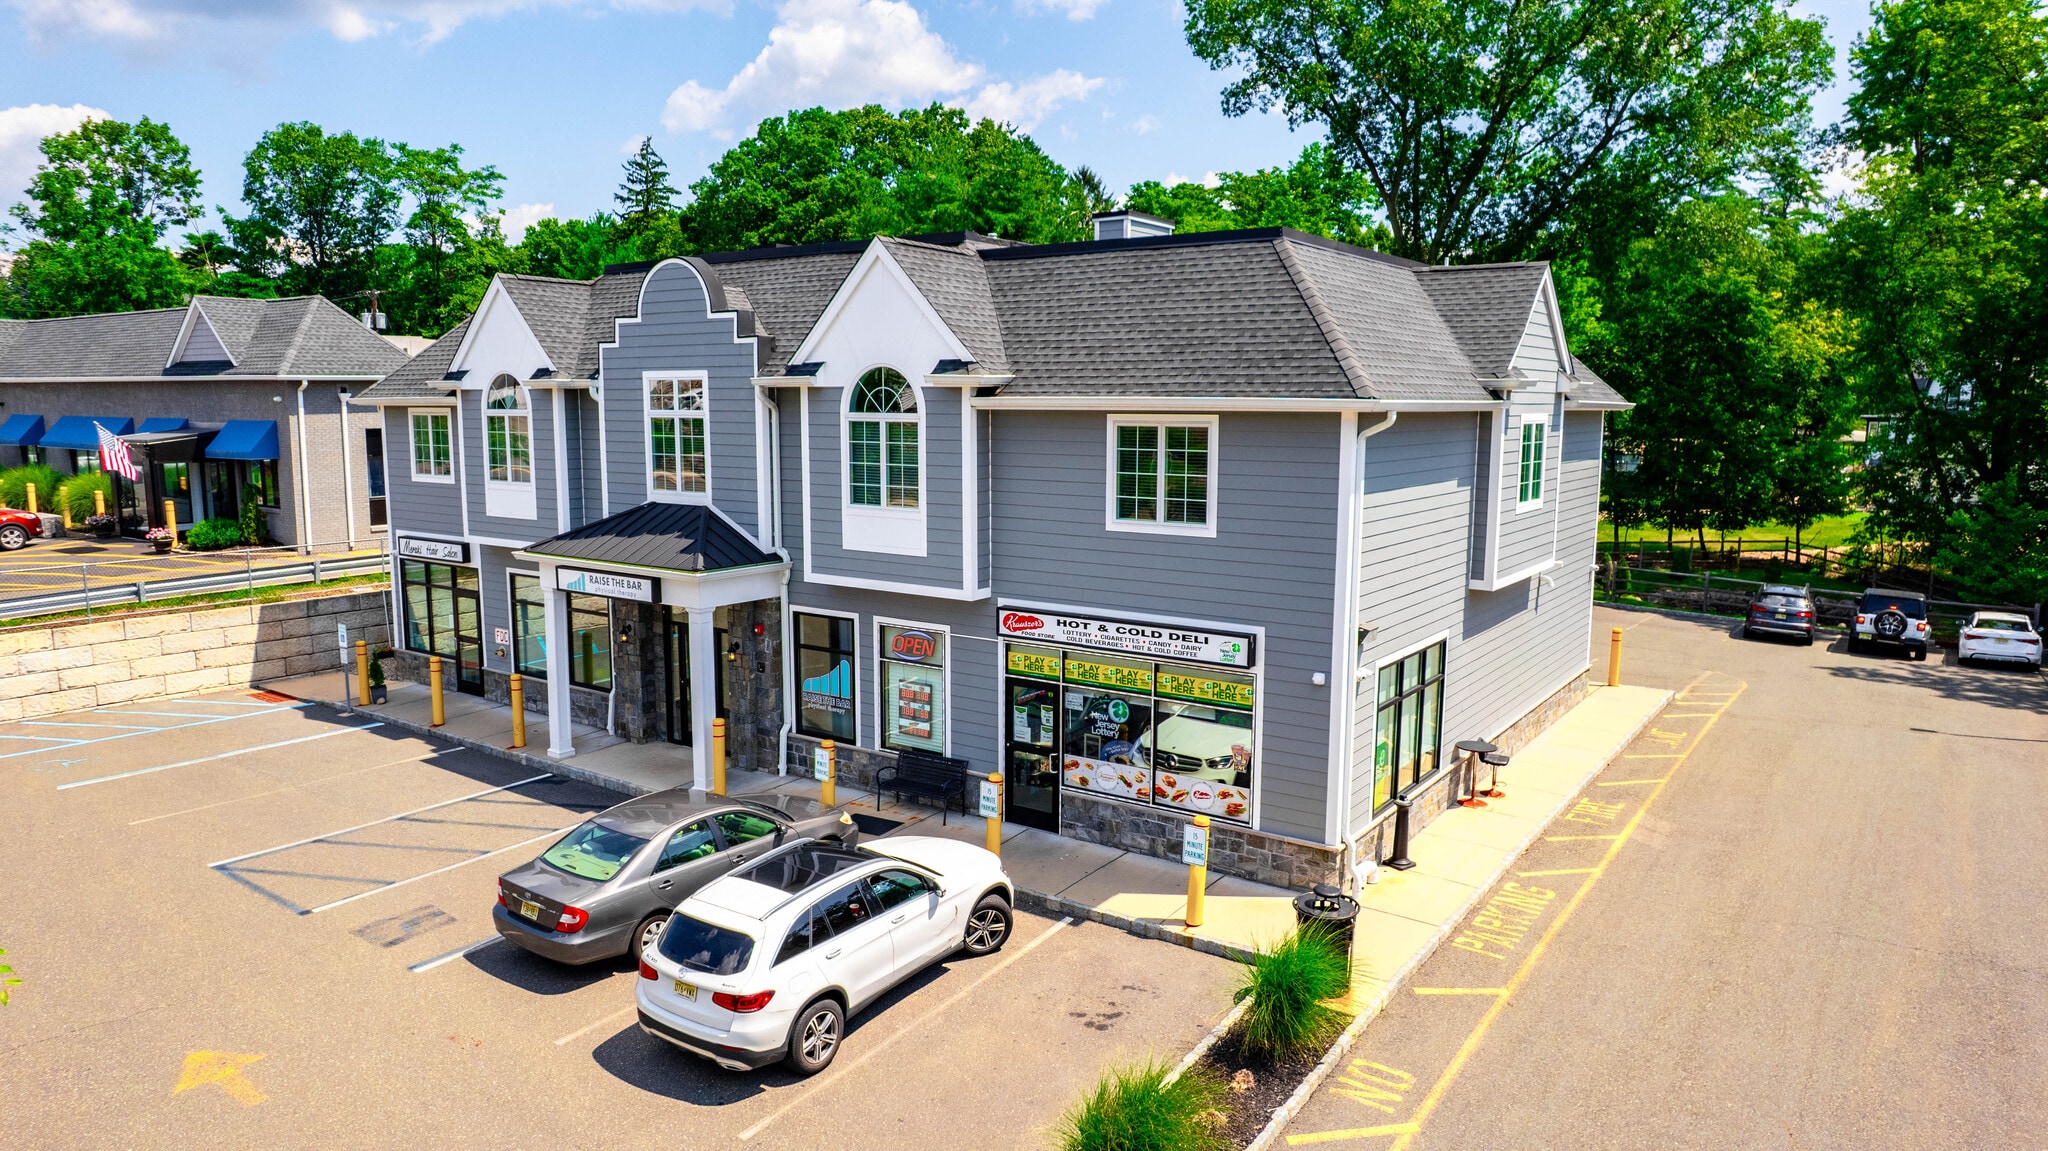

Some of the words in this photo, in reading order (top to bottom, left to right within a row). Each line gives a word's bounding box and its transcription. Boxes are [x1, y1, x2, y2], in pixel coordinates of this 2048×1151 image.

[442, 546, 458, 558] Salon
[589, 575, 610, 586] RAISE
[612, 578, 626, 588] THE
[626, 580, 642, 591] BAR
[594, 586, 616, 594] physical
[616, 588, 637, 598] therapy
[1056, 619, 1091, 630] HOT
[1097, 624, 1109, 632] &
[1116, 626, 1162, 638] COLD
[1168, 632, 1208, 644] DELI
[892, 635, 935, 657] OPEN
[1062, 630, 1092, 638] LOTTERY
[1100, 634, 1140, 644] CIGARETTES
[1148, 640, 1172, 648] CANDY
[1180, 644, 1202, 652] DAIRY
[1085, 638, 1124, 648] BEVERAGES
[1174, 650, 1198, 658] COFFEE
[1024, 656, 1045, 665] PLAY
[1024, 663, 1045, 672] HERE
[1078, 663, 1100, 672] PLAY
[1078, 671, 1100, 680] HERE
[1116, 668, 1139, 678] PLAY
[1116, 676, 1138, 686] HERE
[1170, 676, 1196, 686] PLAY
[1170, 684, 1195, 695] HERE
[1212, 682, 1238, 692] PLAY
[1212, 690, 1238, 702] HERE
[1092, 711, 1108, 720] New
[1094, 720, 1120, 730] Jersey
[1092, 726, 1119, 739] Lottery
[982, 796, 996, 804] MINUTE
[981, 804, 997, 813] PARKING
[1565, 797, 1626, 826] FIRE
[1186, 840, 1203, 850] MINUTE
[1185, 850, 1204, 860] PARKING
[1452, 882, 1556, 960] PARKING
[1328, 1058, 1417, 1114] NO
